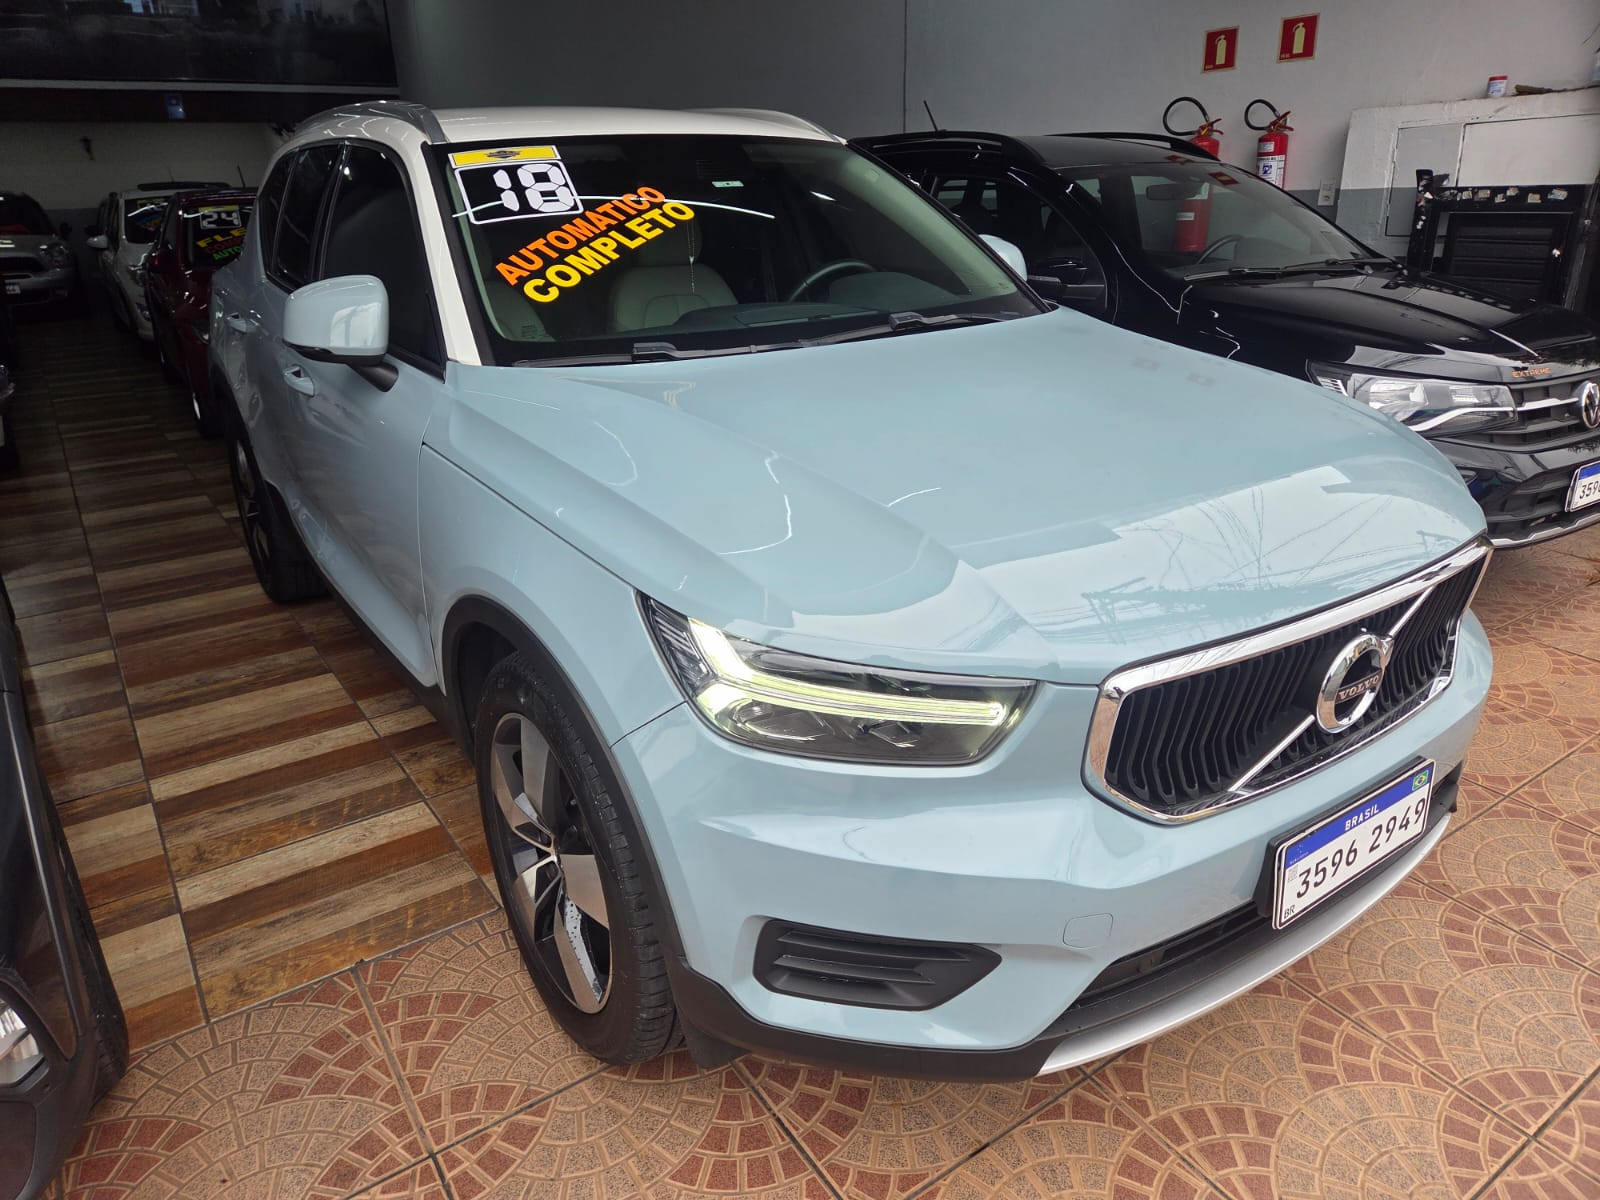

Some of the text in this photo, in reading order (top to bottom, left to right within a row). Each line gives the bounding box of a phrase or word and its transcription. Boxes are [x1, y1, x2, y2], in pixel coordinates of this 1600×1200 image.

[493, 163, 575, 213] 18
[195, 226, 247, 248] FLE
[212, 245, 241, 260] AUTO
[523, 202, 695, 303] COMPLETO
[1338, 674, 1379, 700] VOLVO
[1344, 804, 1379, 831] BRASIL
[1296, 797, 1426, 899] 3596 2949
[1283, 903, 1297, 919] BR
